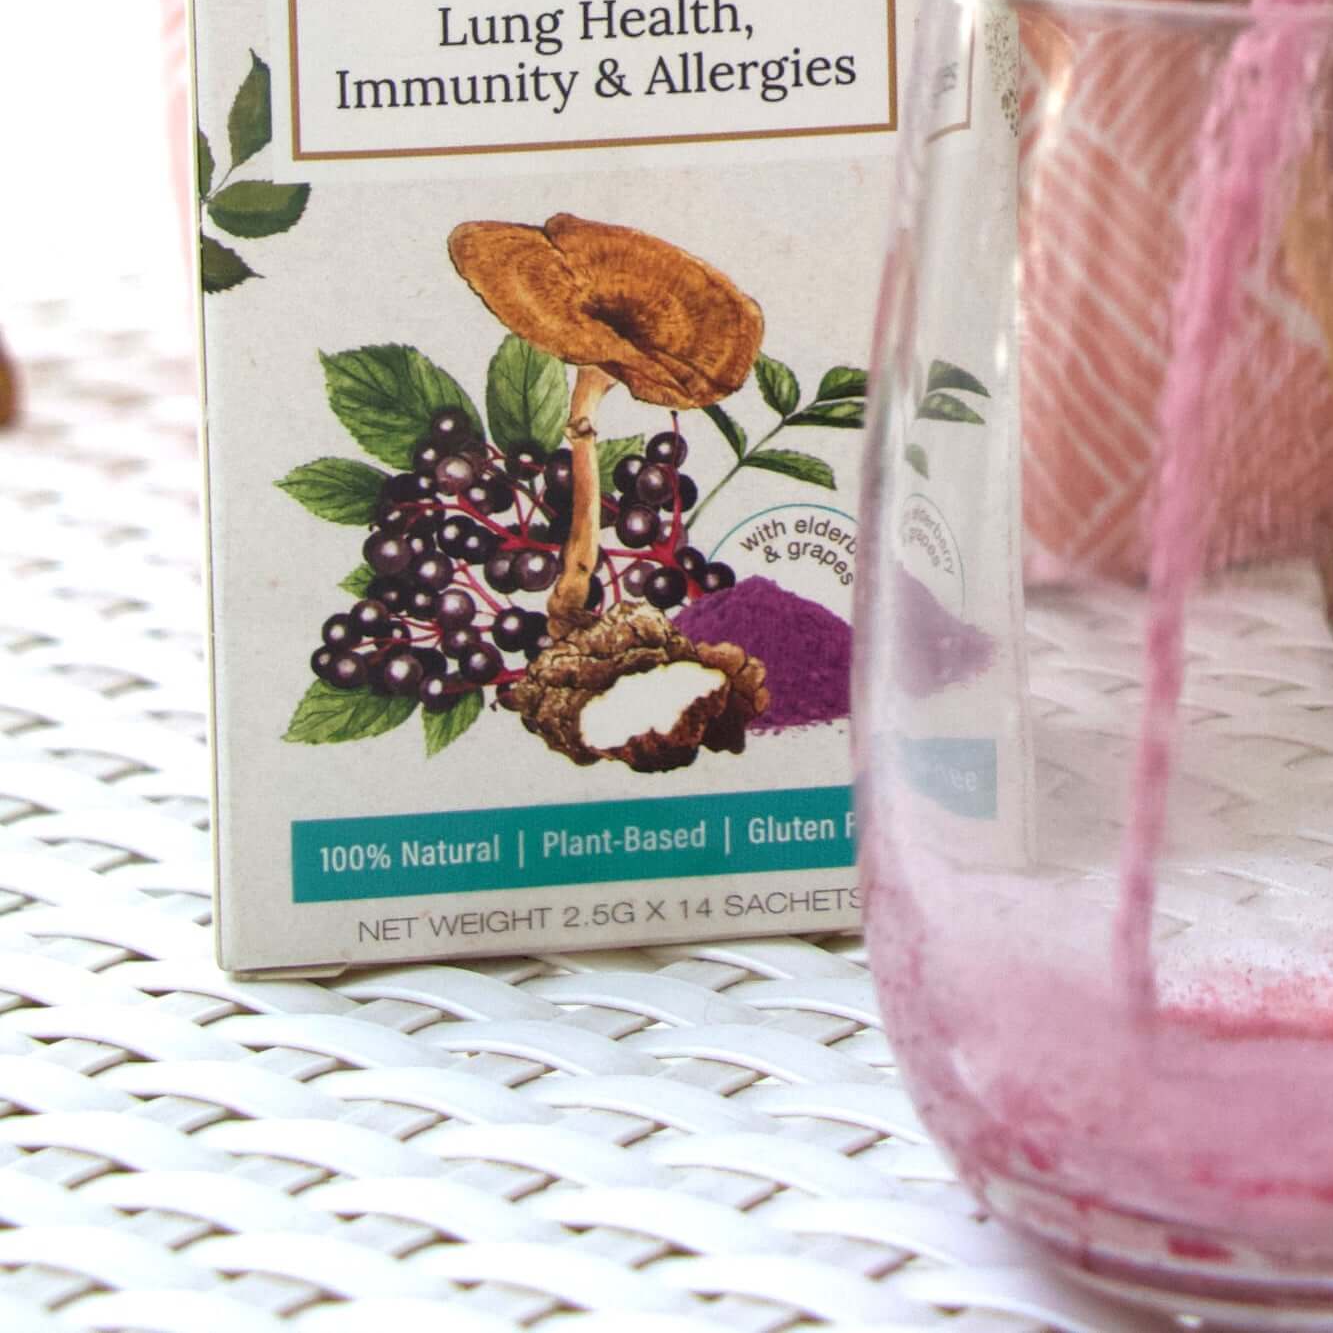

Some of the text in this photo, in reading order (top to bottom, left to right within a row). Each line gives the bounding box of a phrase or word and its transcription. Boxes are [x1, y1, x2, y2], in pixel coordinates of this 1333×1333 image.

[437, 6, 565, 56] Lung
[335, 46, 857, 115] Immunity & Allergies
[738, 515, 857, 555] with elderb
[763, 539, 854, 587] & grapes
[320, 842, 392, 873] 100%
[401, 833, 501, 868] Natural
[542, 822, 707, 859] Plant-Based
[747, 815, 837, 846] Gluten
[358, 917, 419, 943] NET
[429, 907, 552, 937] WEIGHT
[563, 901, 636, 928] 2.5G
[646, 900, 666, 920] X
[679, 898, 713, 918] 14
